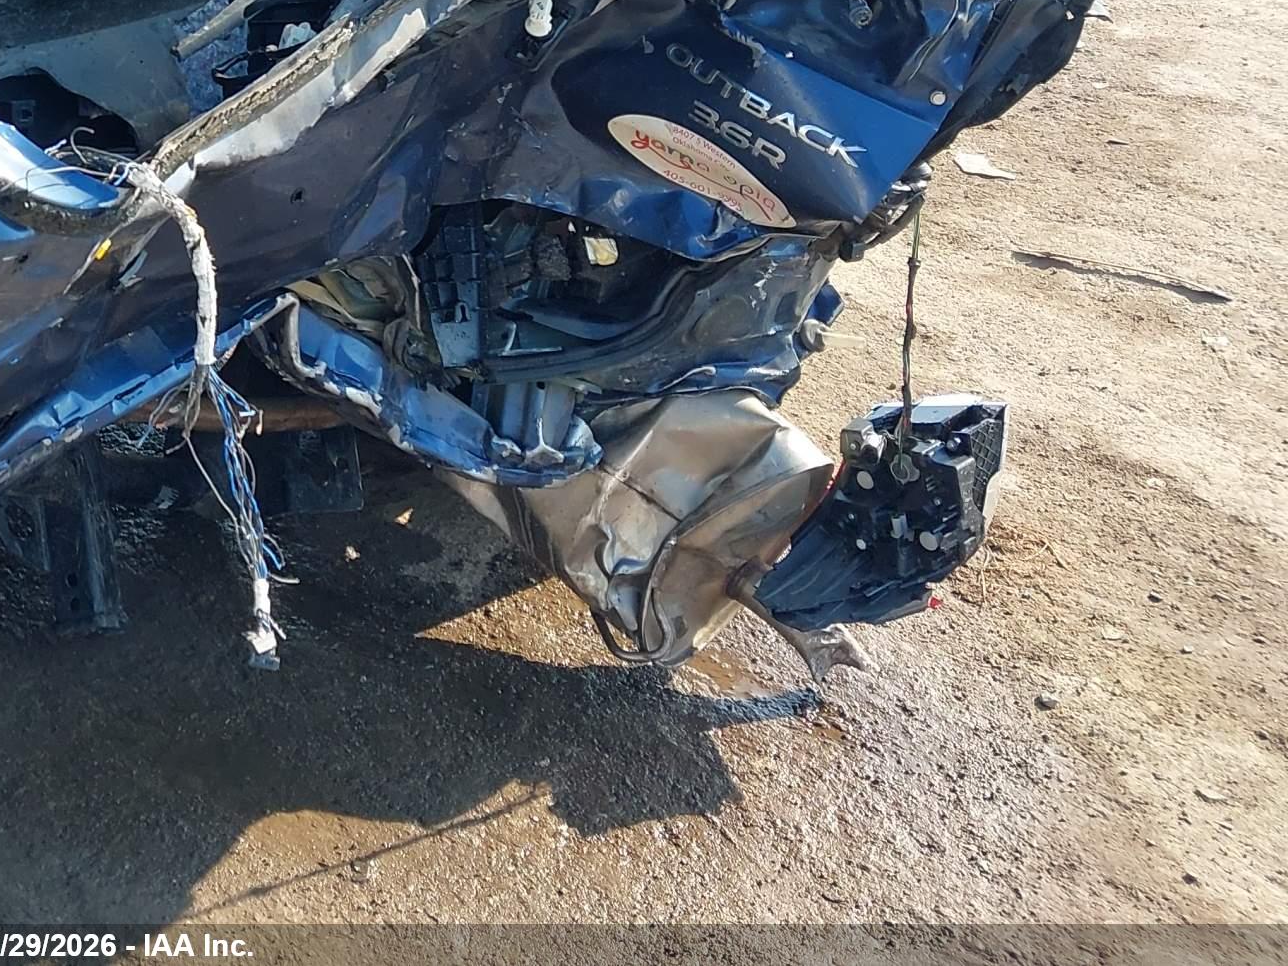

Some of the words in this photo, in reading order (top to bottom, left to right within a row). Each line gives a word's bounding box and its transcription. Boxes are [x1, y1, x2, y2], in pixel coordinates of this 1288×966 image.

[666, 42, 867, 168] OUTBACK
[672, 136, 714, 163] Oklahoma
[688, 99, 787, 172] 3.6R
[702, 142, 737, 169] Western
